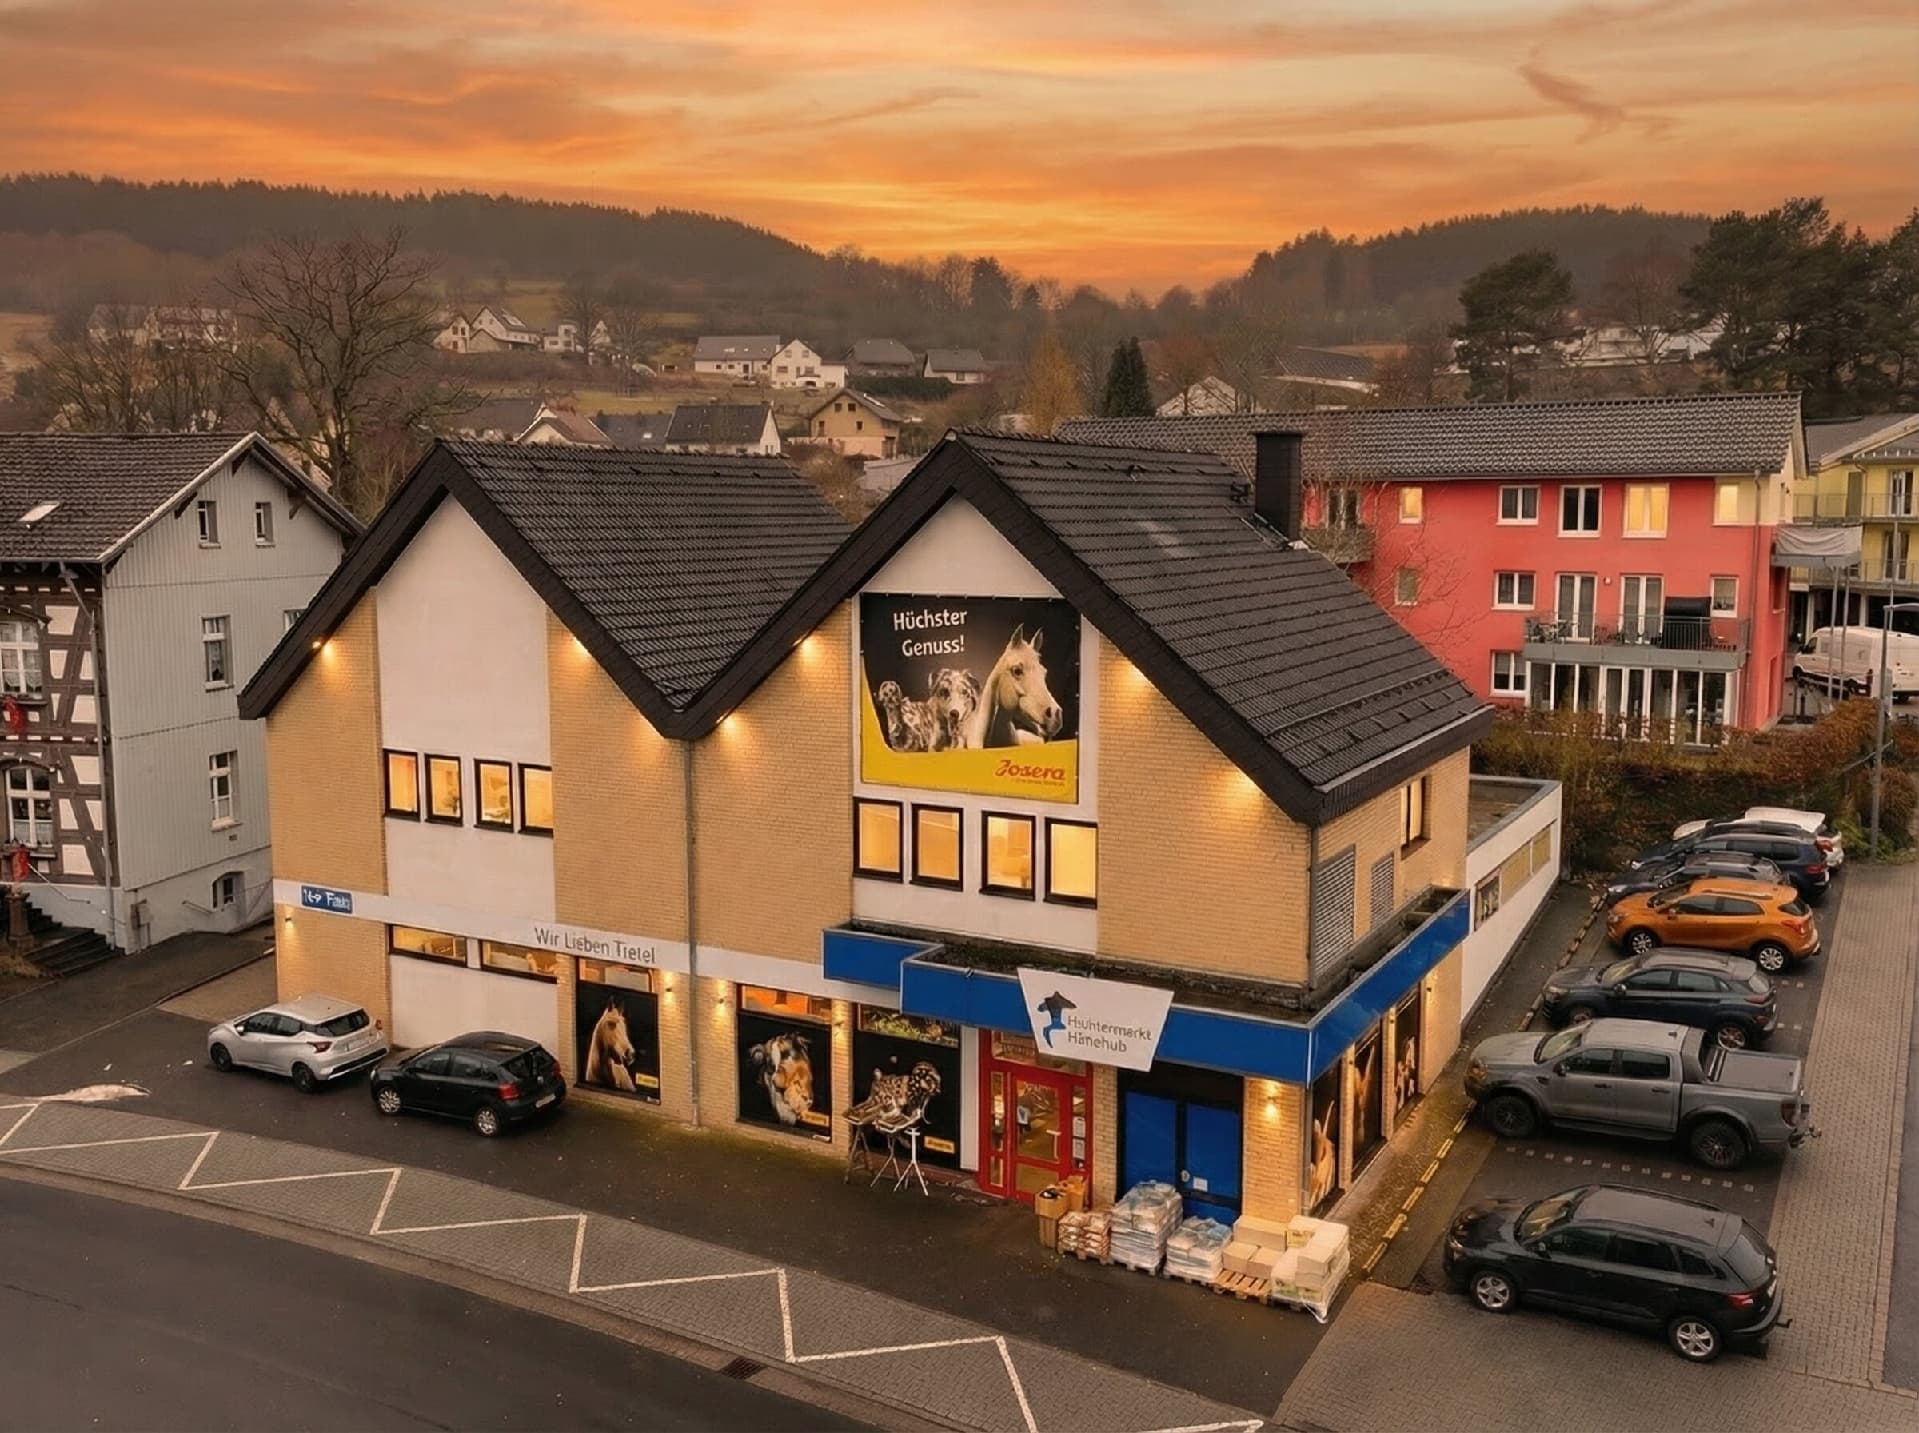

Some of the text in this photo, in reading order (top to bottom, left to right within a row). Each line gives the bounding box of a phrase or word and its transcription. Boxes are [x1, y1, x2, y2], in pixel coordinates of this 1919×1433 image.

[902, 634, 965, 657] Genuss!
[995, 759, 1066, 781] Josera
[534, 927, 559, 946] Wir
